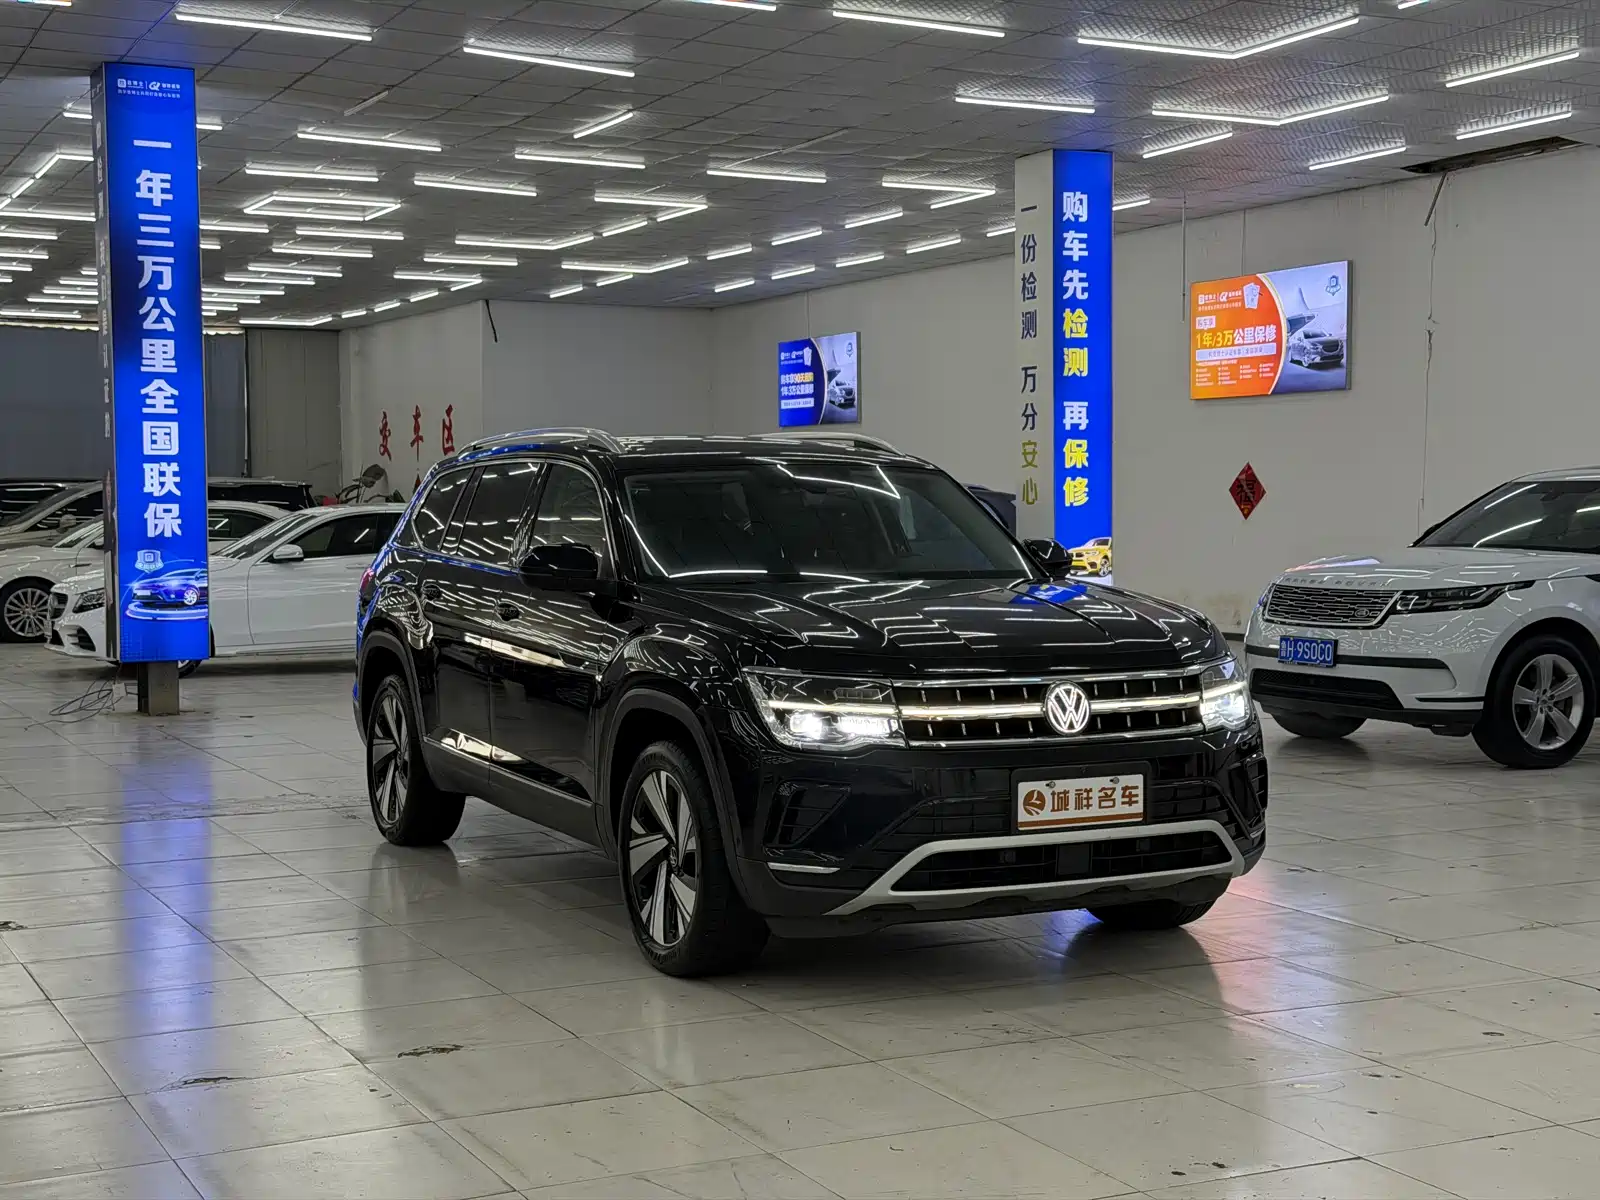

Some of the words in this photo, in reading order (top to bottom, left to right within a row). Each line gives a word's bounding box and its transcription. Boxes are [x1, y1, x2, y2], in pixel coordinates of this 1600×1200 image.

[133, 139, 182, 537] 一年三万公里全国联保
[1020, 205, 1038, 340] 一份检测
[1062, 191, 1089, 377] 购车先检测
[1196, 324, 1277, 348] 1年/3万公里保修
[1020, 365, 1038, 506] 万分安心
[1062, 401, 1090, 507] 再保修
[1050, 785, 1140, 813] 城祥名车
